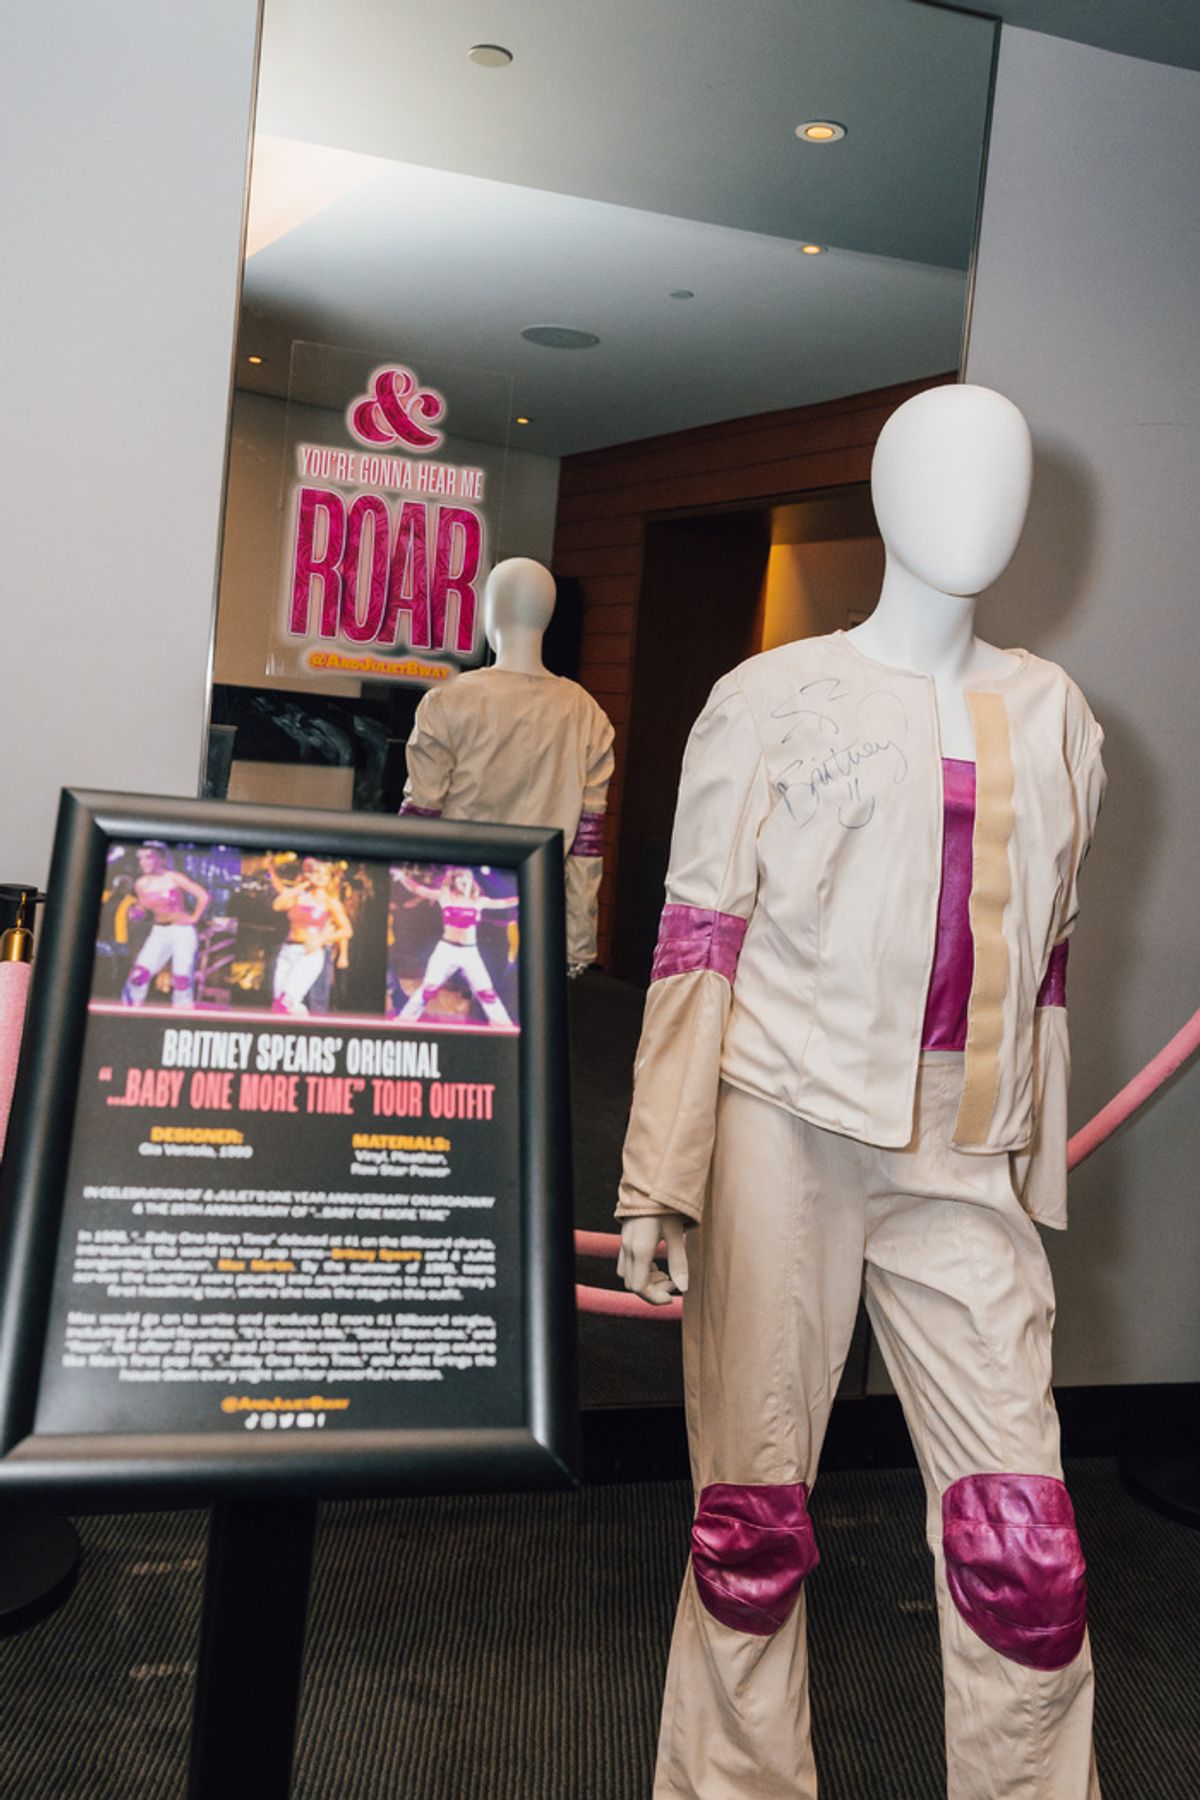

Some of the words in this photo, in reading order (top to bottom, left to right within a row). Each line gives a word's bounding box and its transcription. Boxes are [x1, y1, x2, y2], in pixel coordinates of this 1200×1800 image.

[301, 447, 354, 482] YOU’RE
[360, 455, 412, 491] GONNA
[418, 463, 456, 496] HEAR
[461, 469, 483, 500] ME
[288, 485, 484, 655] ROAR
[161, 1029, 253, 1070] BRITNEY
[256, 1033, 343, 1074] SPEARS’
[347, 1038, 441, 1079] ORIGINAL
[190, 1071, 234, 1110] ONE
[239, 1073, 300, 1113] MORE
[306, 1076, 366, 1115] TIME”
[372, 1079, 423, 1118] TOUR
[430, 1082, 495, 1120] OUTFIT
